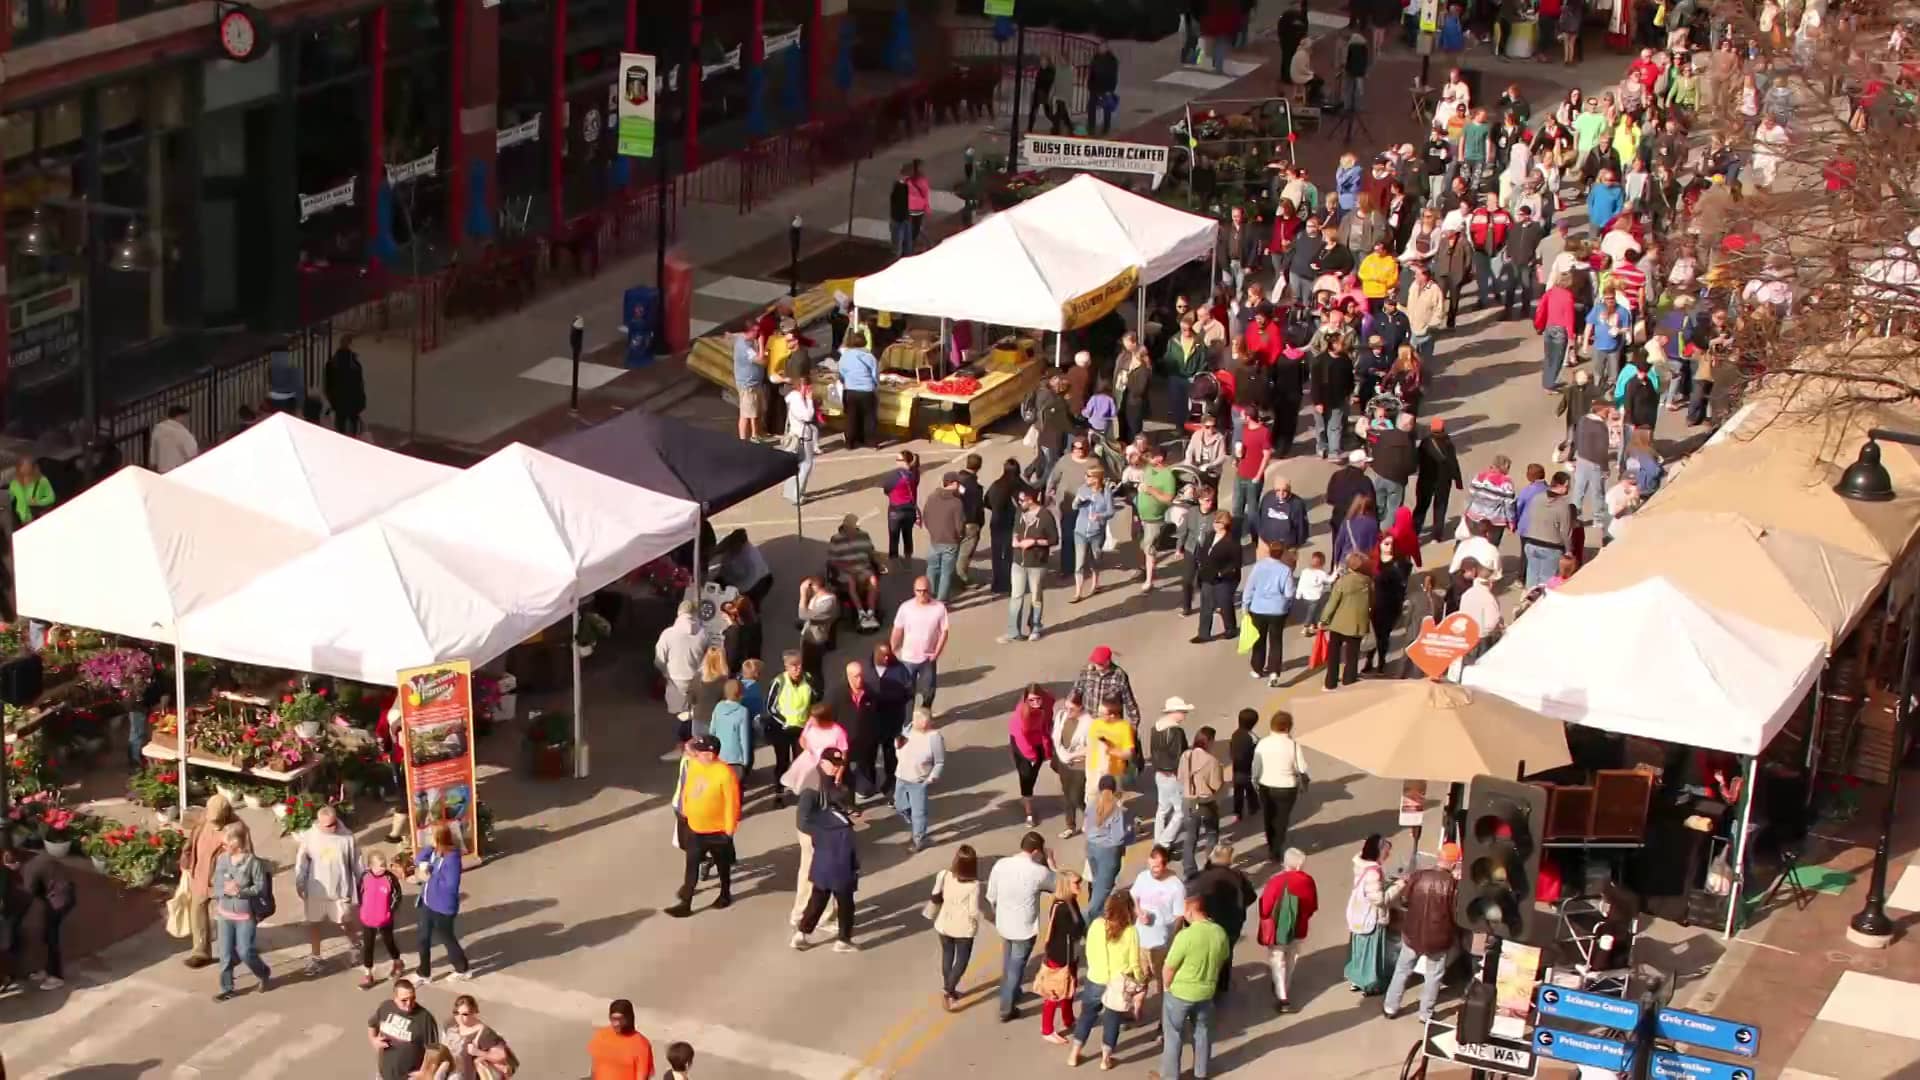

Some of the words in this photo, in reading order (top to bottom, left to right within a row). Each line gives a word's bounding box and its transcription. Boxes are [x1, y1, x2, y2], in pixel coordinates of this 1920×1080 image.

[1033, 141, 1061, 154] BUSY
[1064, 144, 1081, 156] BEE
[1084, 145, 1124, 158] GARDEN
[1126, 148, 1164, 161] CENTER
[1565, 995, 1601, 1009] Science
[1602, 1003, 1635, 1016] Center
[1660, 1013, 1682, 1024] Civic
[1683, 1018, 1717, 1033] Center
[1493, 1047, 1524, 1064] WAY
[1559, 1036, 1602, 1051] Principal
[1602, 1045, 1625, 1056] Park
[1658, 1056, 1713, 1074] Convention
